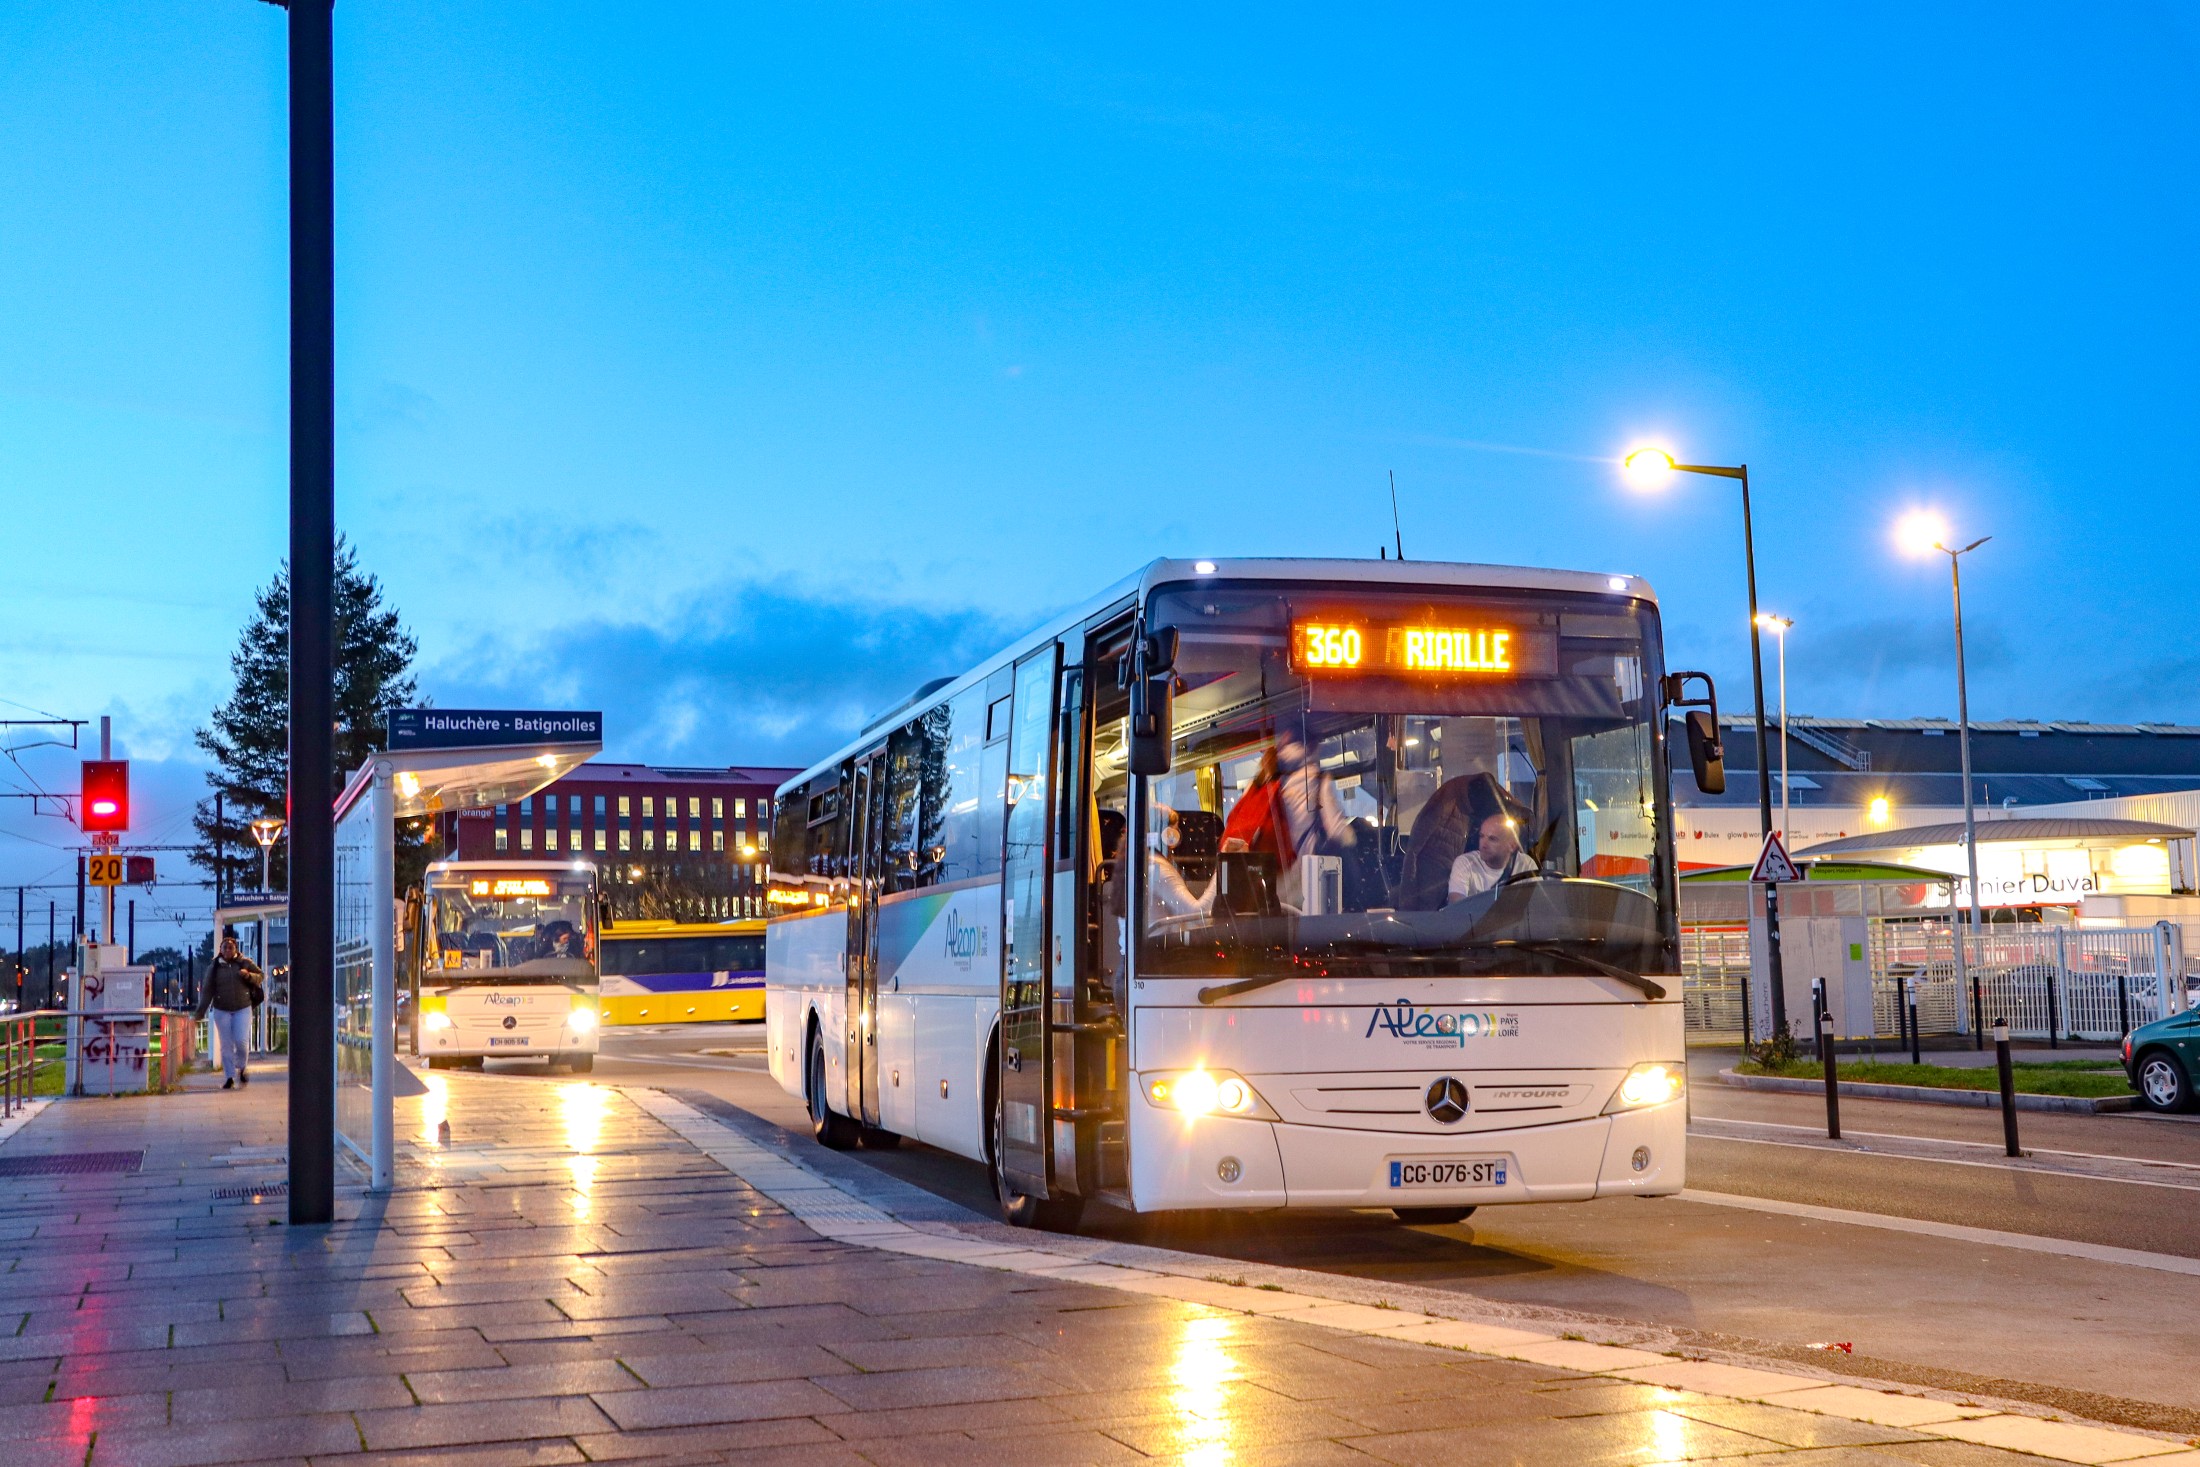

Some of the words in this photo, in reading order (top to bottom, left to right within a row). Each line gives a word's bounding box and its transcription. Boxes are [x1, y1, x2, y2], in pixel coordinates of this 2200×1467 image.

[1306, 624, 1362, 668] 360
[1405, 626, 1511, 672] RIAILLE
[425, 716, 500, 730] Haluchère
[514, 717, 596, 734] Batignolles
[462, 809, 492, 819] orange
[91, 860, 120, 880] 20
[2033, 872, 2099, 894] Duval
[234, 894, 265, 902] Haluchère
[1134, 980, 1145, 990] 310
[1500, 1017, 1519, 1025] PAYS
[1498, 1028, 1519, 1037] LOIRE
[1493, 1090, 1570, 1099] INTOURO
[1402, 1164, 1495, 1183] CG-076-ST
[1496, 1172, 1506, 1183] 44
